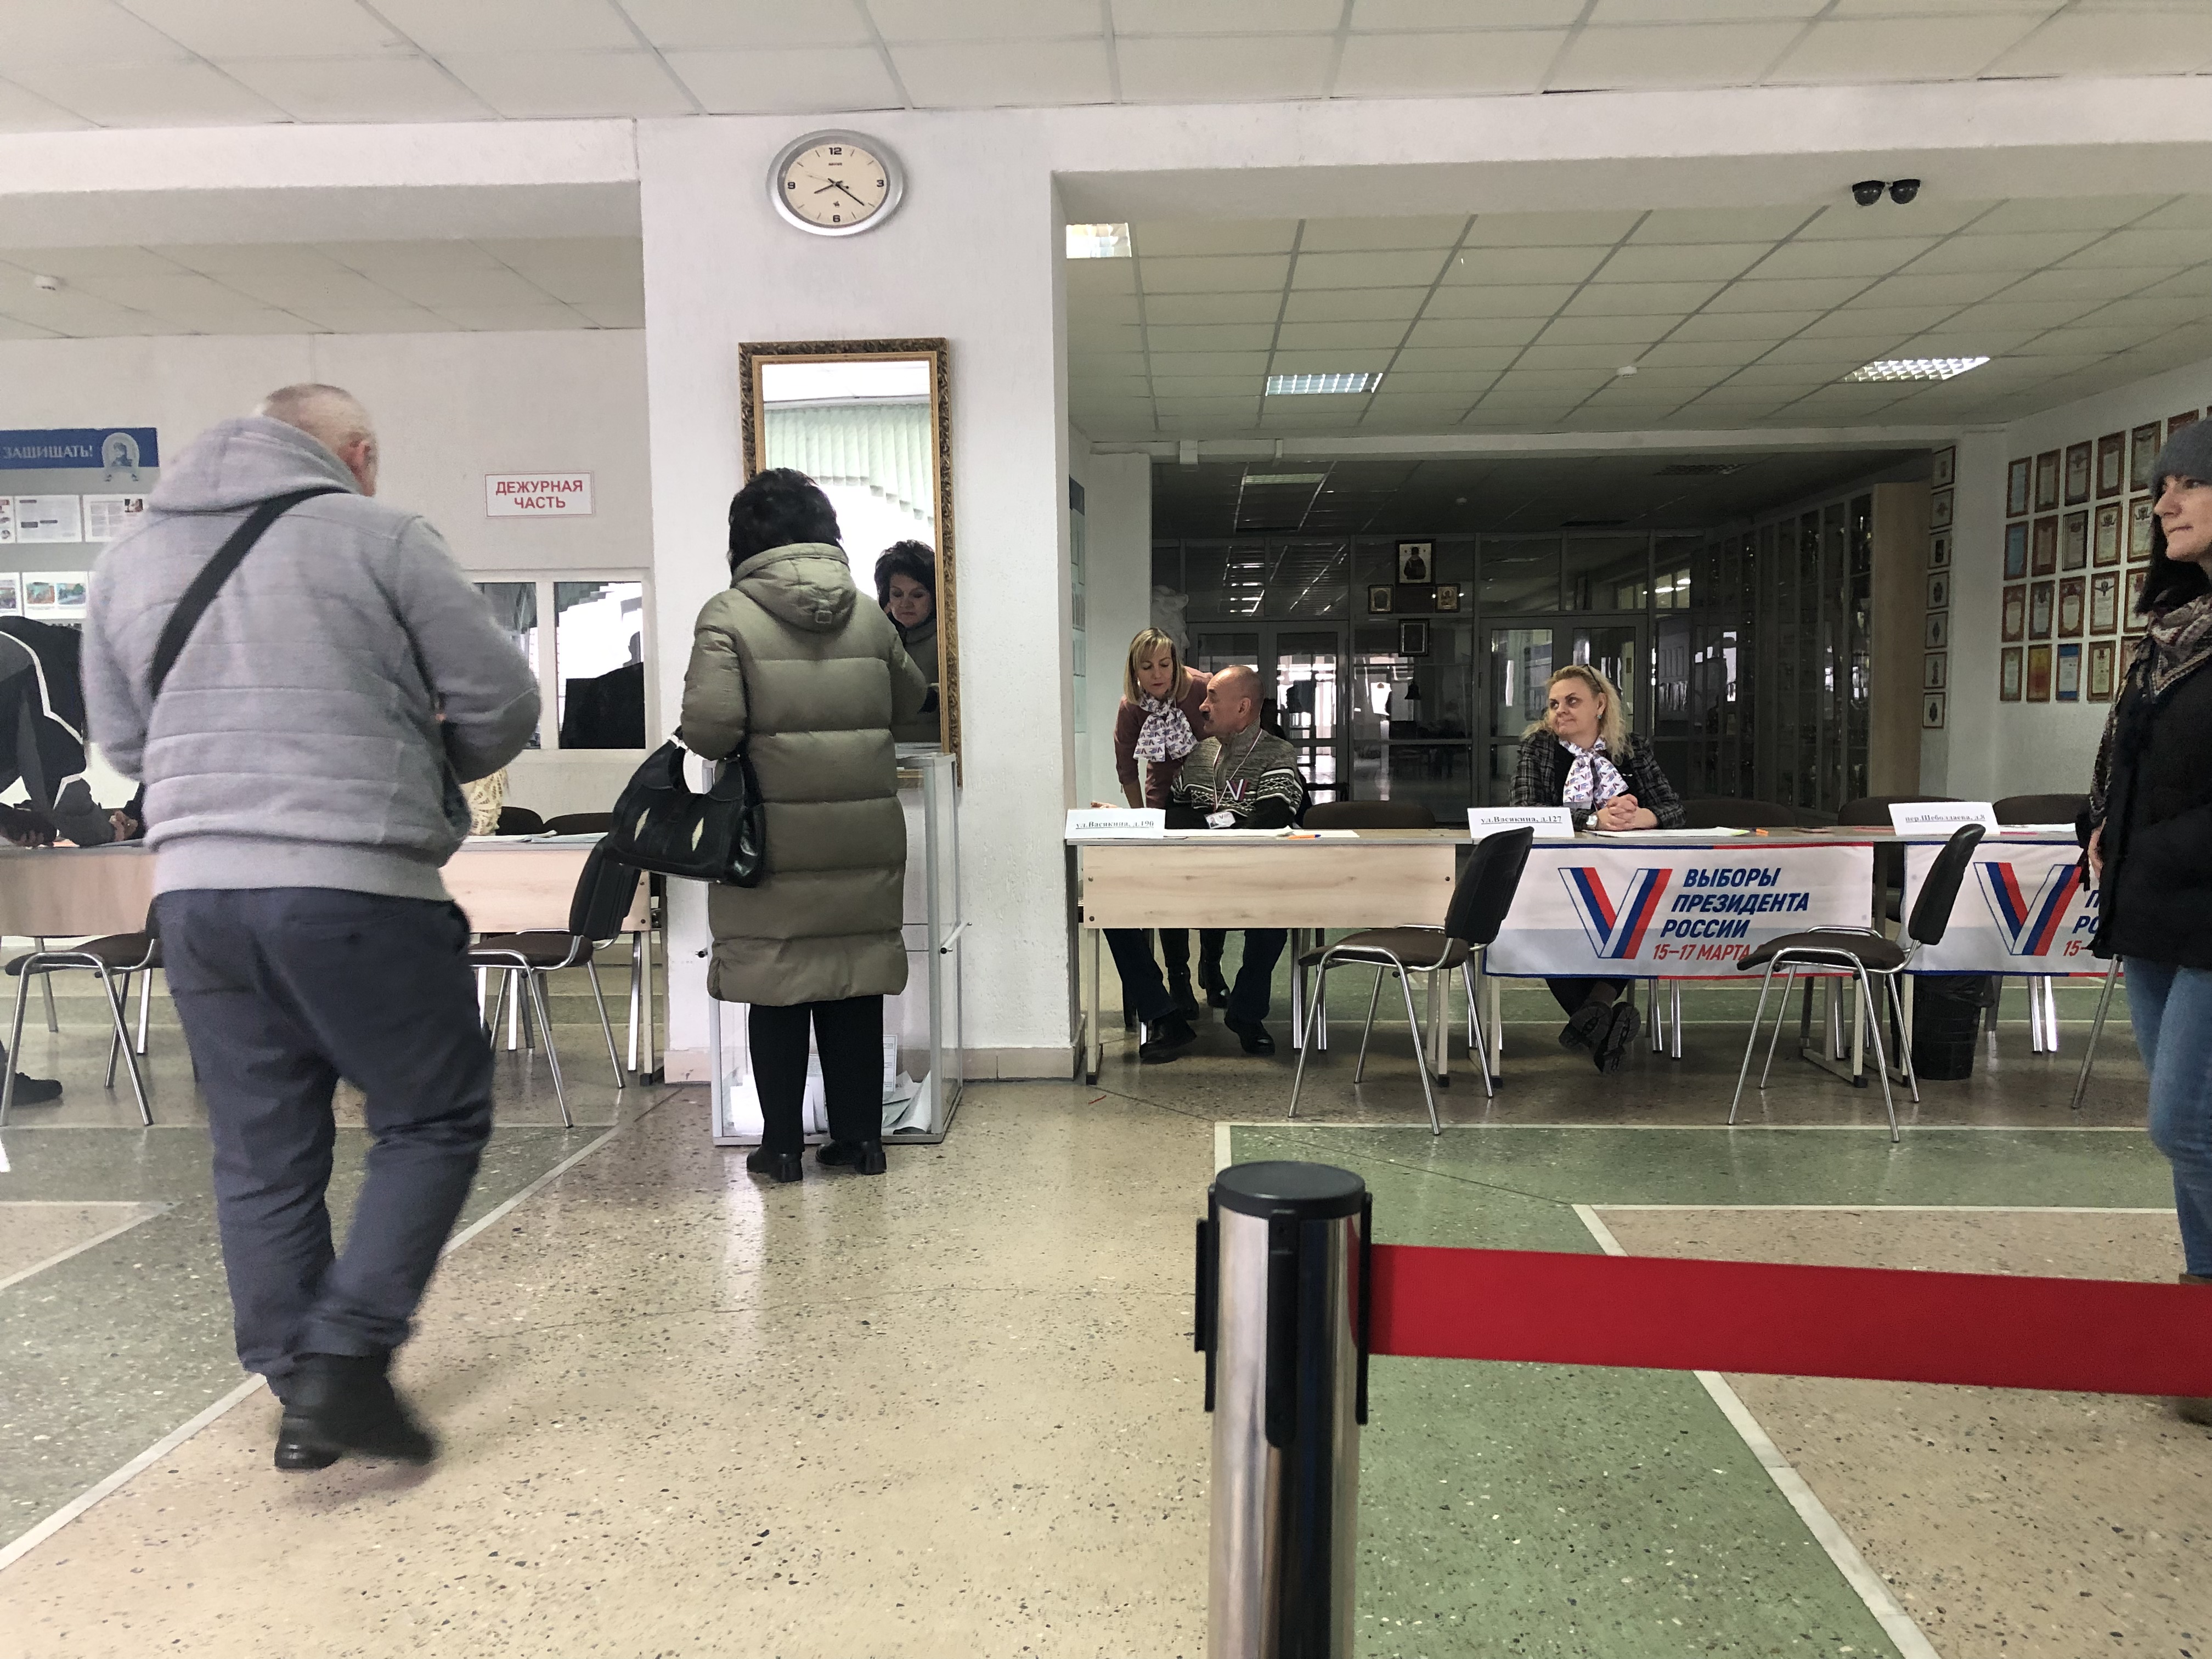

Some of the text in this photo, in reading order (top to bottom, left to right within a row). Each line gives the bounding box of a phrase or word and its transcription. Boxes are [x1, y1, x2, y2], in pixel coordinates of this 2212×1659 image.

[828, 147, 842, 155] 12
[495, 480, 583, 495] ДЕЖУРНАЯ
[514, 496, 566, 509] ЧАСТЬ
[1683, 867, 1781, 888] ВЫБОРЫ
[1671, 892, 1809, 915] ПРЕЗИДЕНТА
[1660, 919, 1750, 938] РОССИИ
[1696, 944, 1750, 960] МАРТА
